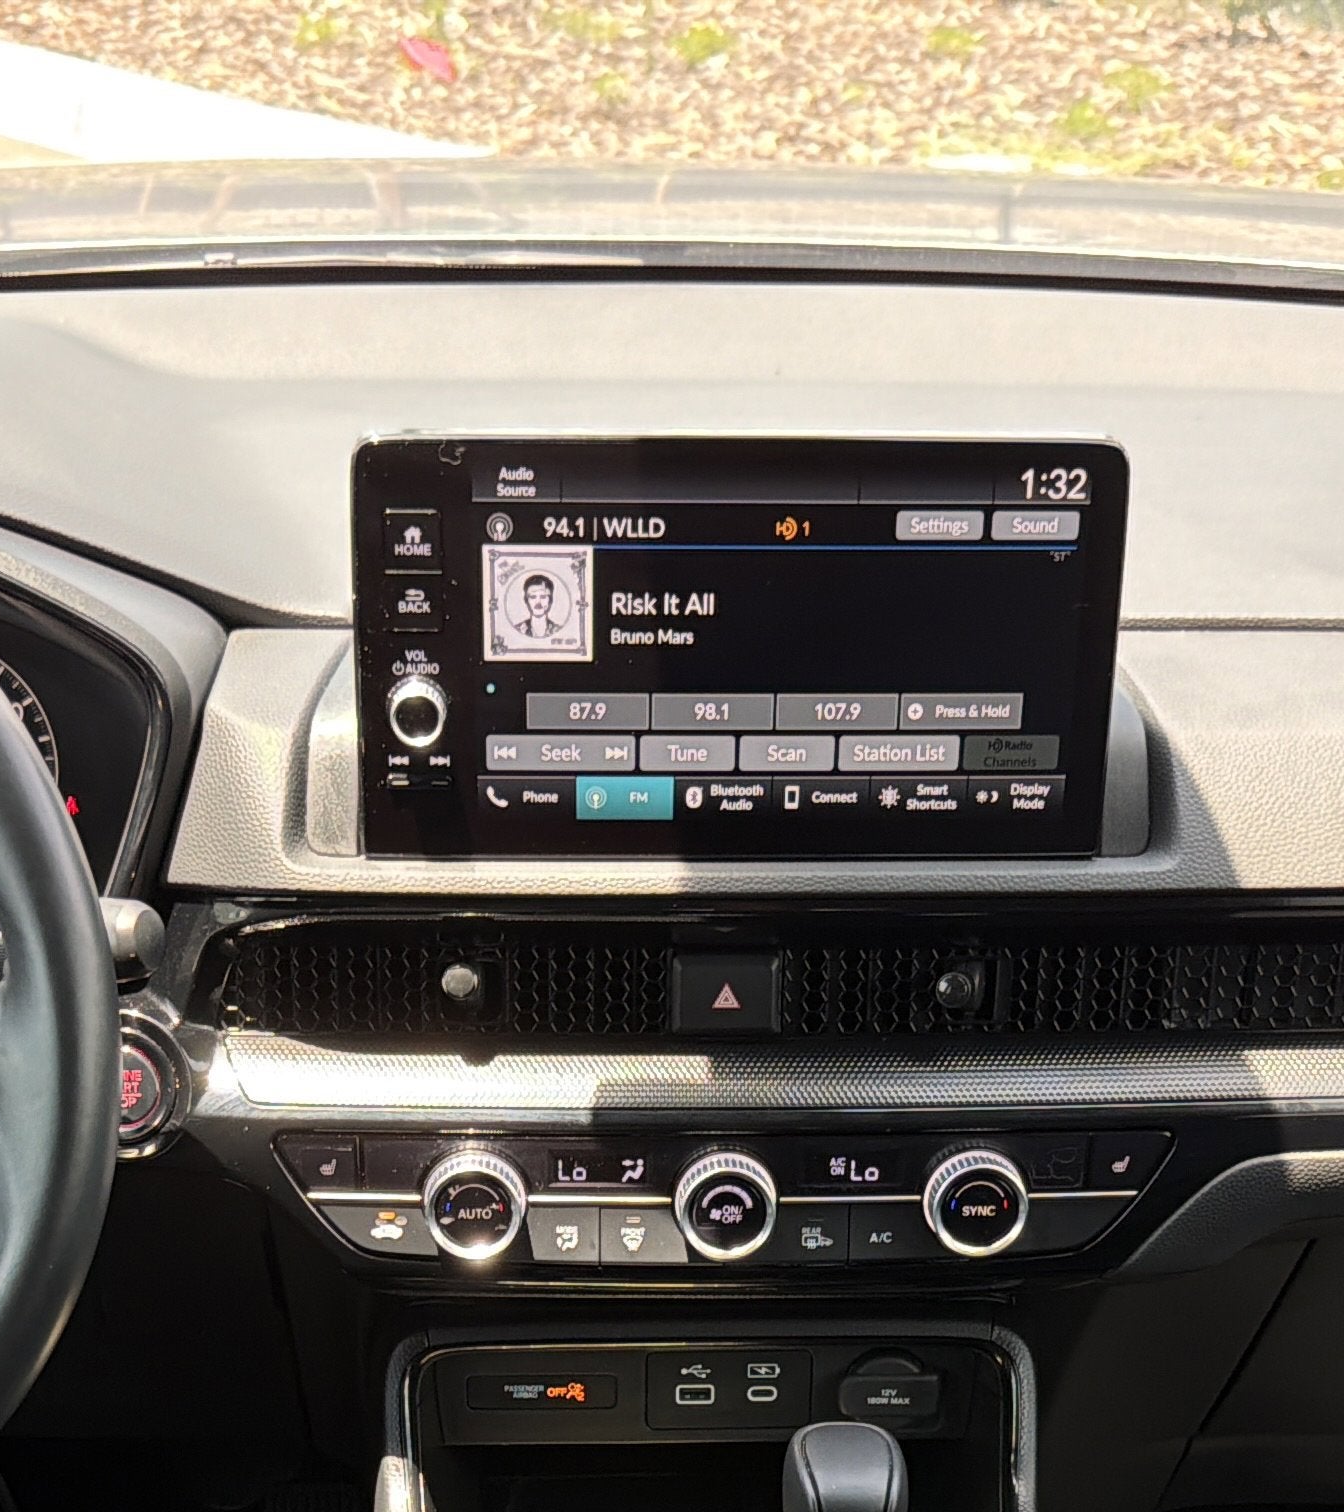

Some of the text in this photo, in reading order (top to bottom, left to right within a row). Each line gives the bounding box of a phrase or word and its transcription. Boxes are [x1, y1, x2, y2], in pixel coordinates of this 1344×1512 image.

[498, 466, 535, 481] Audio
[496, 483, 537, 498] Source
[1020, 467, 1088, 500] 1:32
[542, 516, 586, 538] 94.1
[603, 516, 666, 539] WLLD
[910, 516, 969, 536] Settings
[1012, 517, 1059, 534] Sound
[394, 543, 432, 557] HOME
[397, 601, 431, 614] BACK
[611, 592, 716, 616] Risk It All
[610, 628, 695, 645] Bruno Mars
[405, 650, 428, 662] VOL
[405, 662, 440, 675] AUDIO
[569, 702, 607, 721] 87.9
[694, 702, 729, 721] 98.1
[814, 702, 862, 721] 107.9
[934, 704, 1011, 719] Press & Hold
[540, 743, 582, 762] Seek
[1004, 740, 1033, 751] Radio
[666, 744, 708, 762] Tune
[767, 744, 807, 762] Scan
[853, 744, 946, 763] Station List
[983, 756, 1037, 768] Channels
[522, 790, 559, 804] Phone
[709, 783, 764, 797] Bluetooth
[916, 784, 949, 796] Smart
[1010, 783, 1051, 797] Display
[629, 791, 649, 804] FM
[811, 791, 858, 804] Connect
[906, 798, 958, 811] Shortcuts
[1012, 798, 1045, 811] Mode
[719, 798, 753, 812] Audio
[829, 1157, 847, 1167] A/C
[830, 1166, 846, 1176] ON
[850, 1159, 880, 1182] Lo
[457, 1208, 493, 1220] AUTO
[722, 1204, 744, 1215] ON/
[961, 1205, 997, 1217] SYNC
[721, 1214, 743, 1225] OFF
[868, 1231, 893, 1244] A/C
[546, 1386, 568, 1398] OFF
[890, 1397, 911, 1405] MAX
